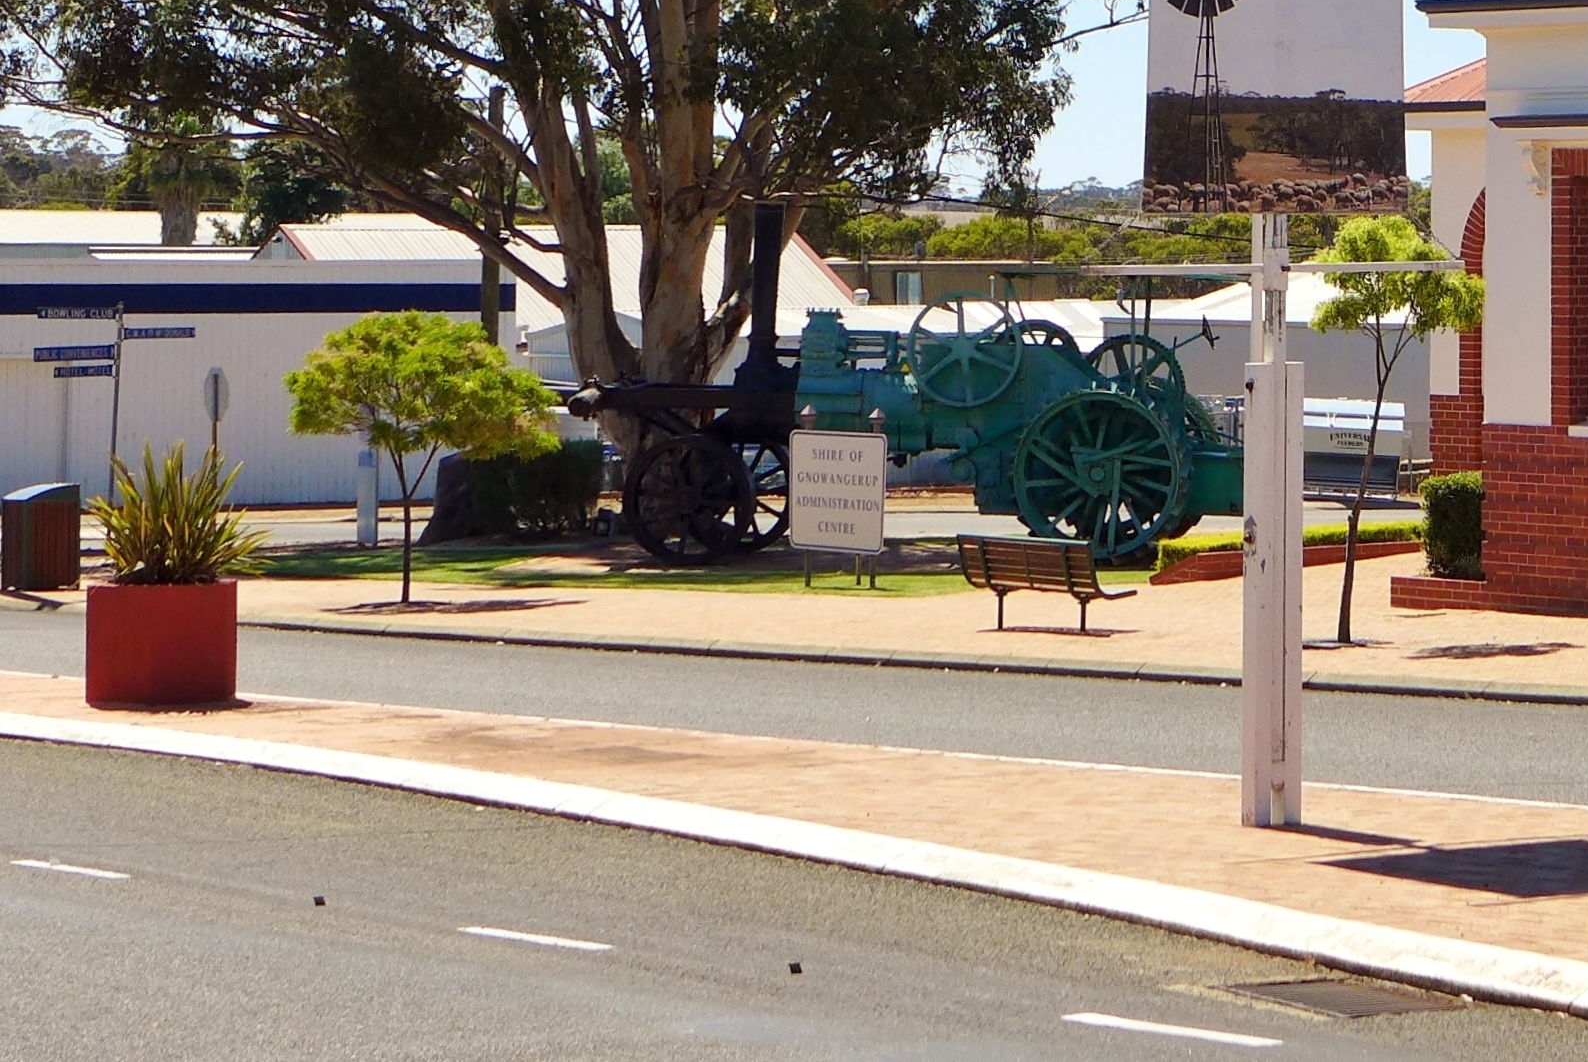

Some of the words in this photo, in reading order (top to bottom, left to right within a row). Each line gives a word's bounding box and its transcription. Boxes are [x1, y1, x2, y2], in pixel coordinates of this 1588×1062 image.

[47, 308, 86, 318] BOWLING
[90, 309, 114, 319] CLUB
[812, 448, 844, 461] SHIRE
[849, 450, 864, 462] OF
[797, 472, 879, 487] GNOWANGERUP
[795, 496, 881, 512] ADMINISTRATION
[817, 521, 856, 535] CENTRE
